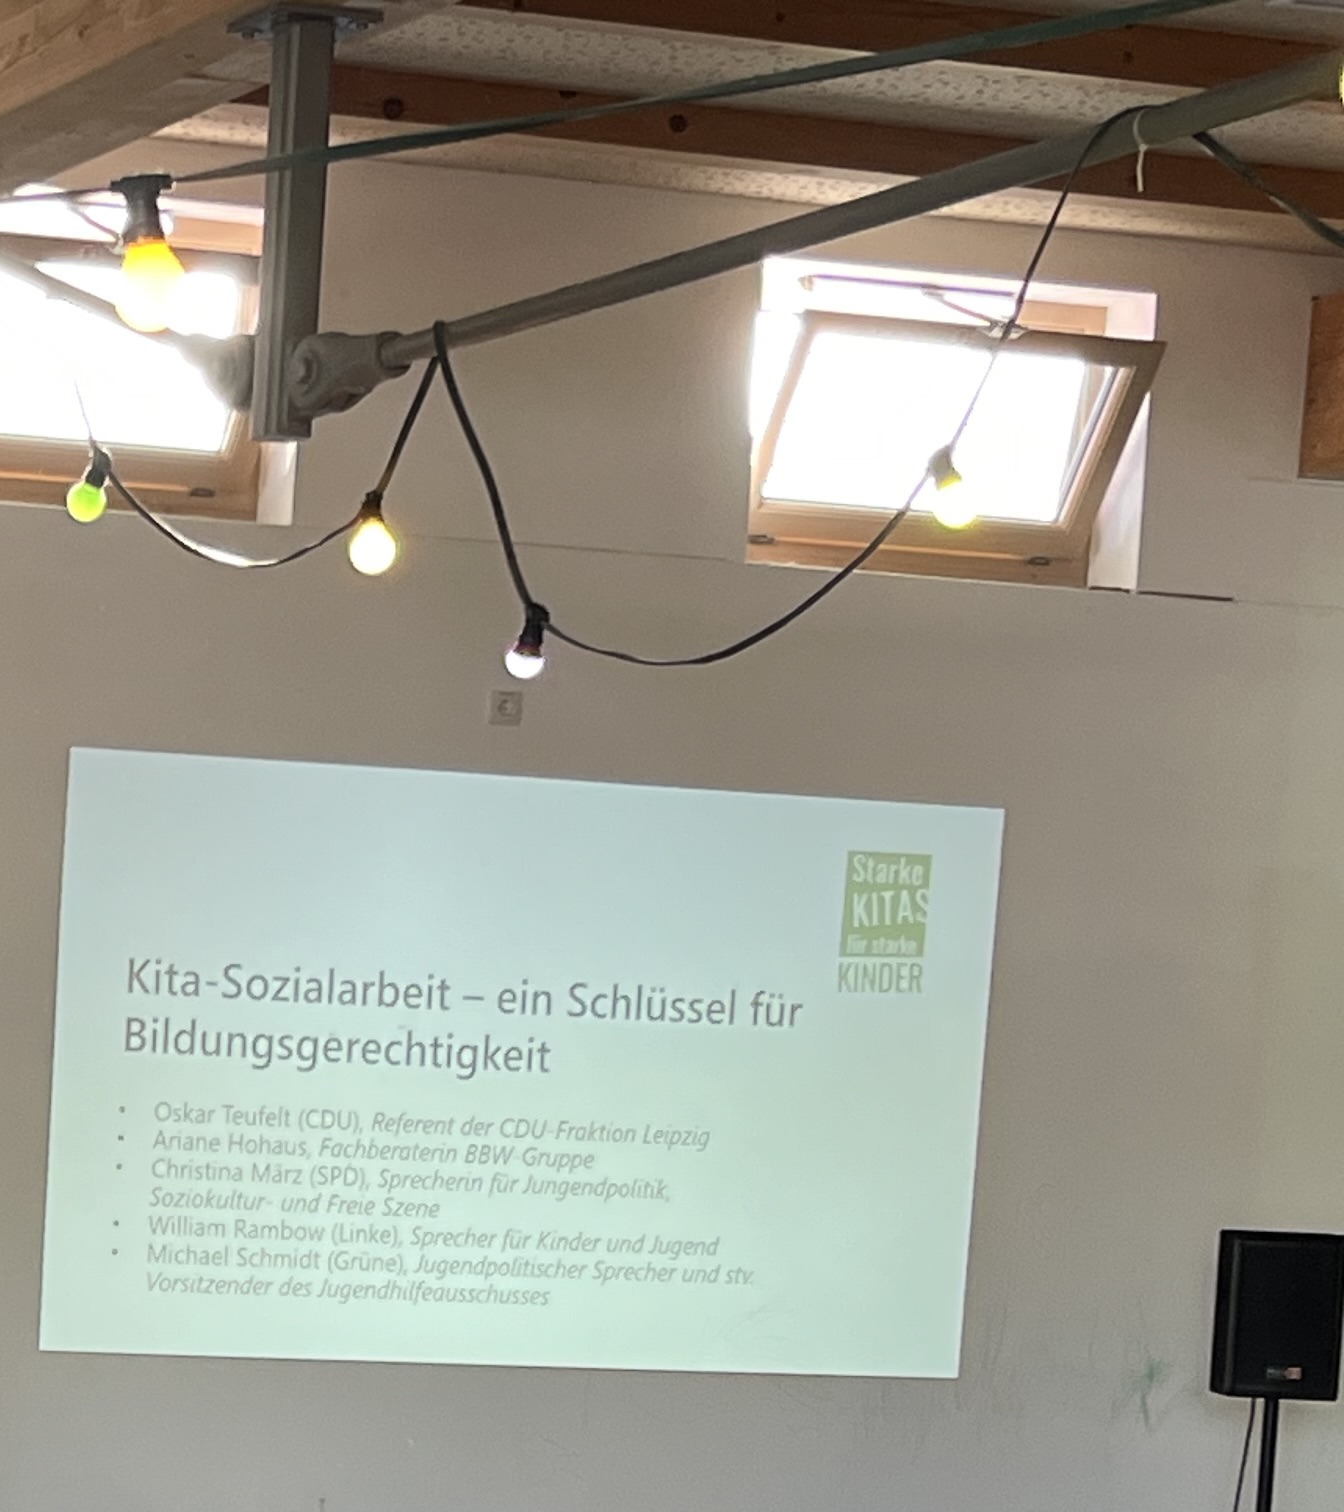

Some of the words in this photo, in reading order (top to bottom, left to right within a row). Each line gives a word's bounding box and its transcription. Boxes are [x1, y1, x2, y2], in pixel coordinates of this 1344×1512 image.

[852, 854, 924, 885] Starke
[853, 889, 929, 928] KITAS
[126, 957, 451, 1011] Kita-Sozialarbeit
[497, 979, 553, 1016] ein
[566, 982, 736, 1025] Schlüssel
[750, 989, 803, 1028] für
[838, 962, 922, 993] KINDER
[124, 1016, 551, 1080] Bildungsgerechtigkeit
[154, 1101, 216, 1124] Oskar
[298, 1108, 363, 1135] (CDU),
[371, 1111, 455, 1137] Referent
[460, 1115, 494, 1137] der
[499, 1117, 637, 1143] CDU-Fraktion
[642, 1123, 711, 1152] Leipzig
[152, 1130, 221, 1152] Ariane
[227, 1133, 311, 1160] Hohaus,
[318, 1137, 458, 1163] Fachberaterin
[151, 1158, 243, 1182] Christina
[250, 1162, 303, 1185] März
[310, 1165, 370, 1190] (SPD),
[378, 1168, 483, 1194] Sprecherin
[489, 1172, 520, 1198] für
[280, 1193, 322, 1215] und
[326, 1194, 376, 1216] Freie
[381, 1196, 441, 1218] Szene
[147, 1215, 226, 1238] William
[233, 1218, 325, 1241] Rambow
[330, 1222, 404, 1248] (Linke),
[410, 1225, 497, 1251] Sprecher
[501, 1228, 532, 1253] für
[536, 1230, 602, 1252] Kinder
[606, 1233, 646, 1253] und
[647, 1236, 721, 1261] Jugend
[146, 1243, 229, 1267] Michael
[235, 1247, 322, 1271] Schmidt
[327, 1250, 408, 1277] (Grüne),
[413, 1253, 588, 1280] Jugendpolitischer
[591, 1259, 677, 1286] Sprecher
[682, 1263, 721, 1285] und
[724, 1266, 756, 1285] stv.
[146, 1271, 275, 1297] Vorsitzender
[277, 1276, 312, 1298] des
[315, 1278, 551, 1306] Jugendhilfeausschusses
